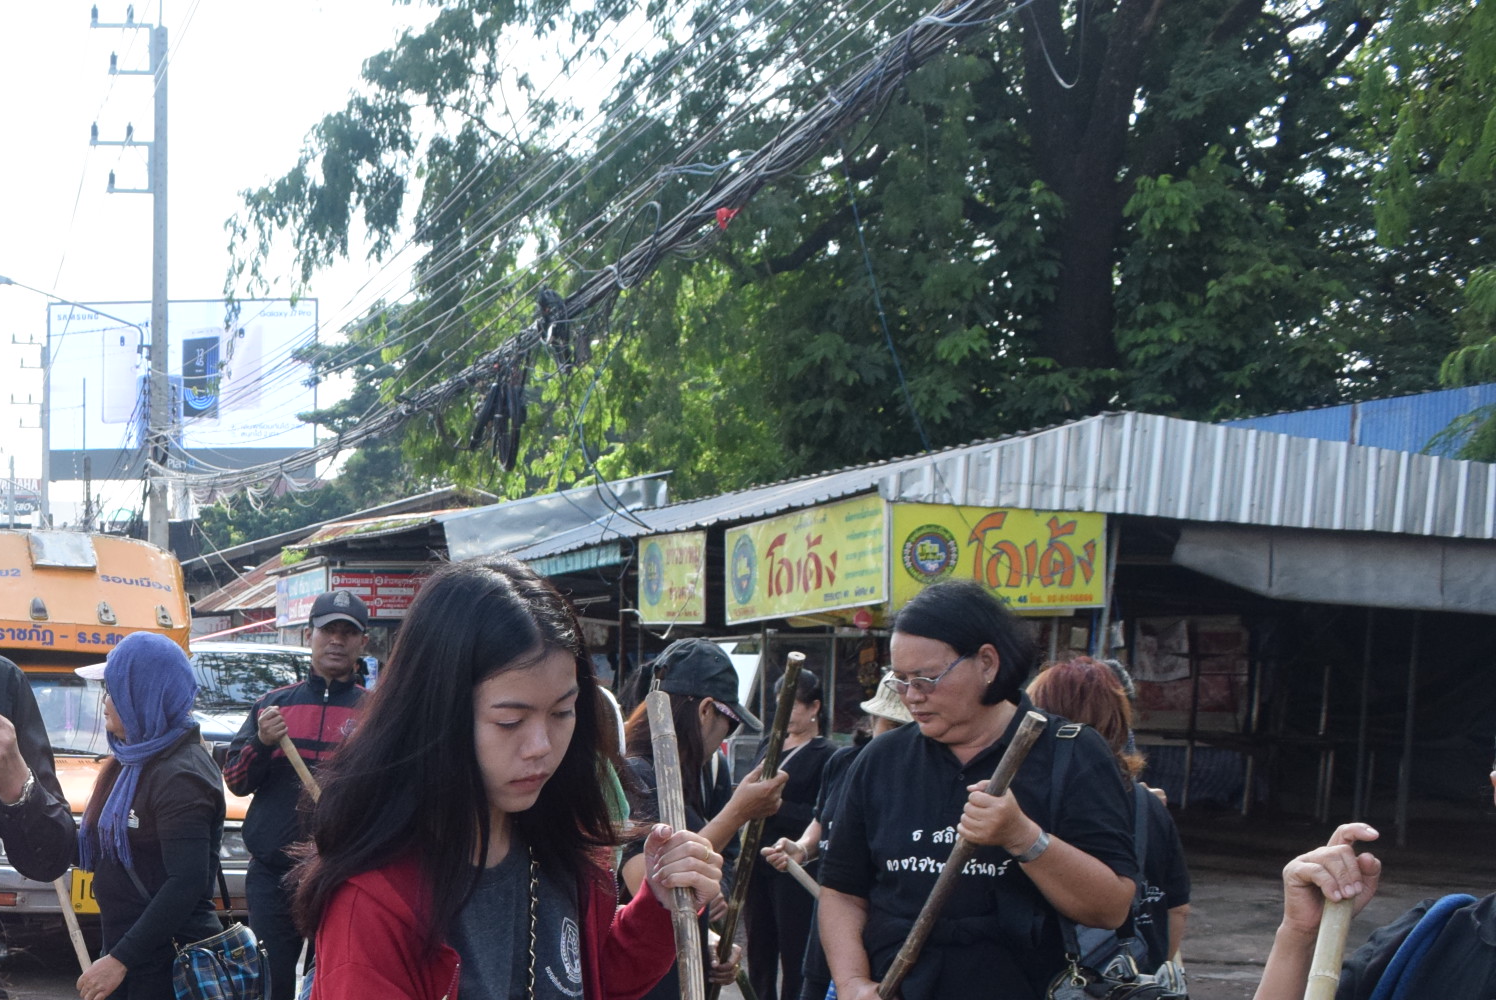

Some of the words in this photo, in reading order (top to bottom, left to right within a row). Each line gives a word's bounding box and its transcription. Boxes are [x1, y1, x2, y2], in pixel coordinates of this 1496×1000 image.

[57, 313, 99, 321] SAMSUNG
[260, 310, 287, 318] Galaxy
[298, 309, 312, 317] Pro
[100, 573, 172, 592] รอบเมือง
[912, 829, 924, 842] ธ
[932, 826, 959, 844] สถิ
